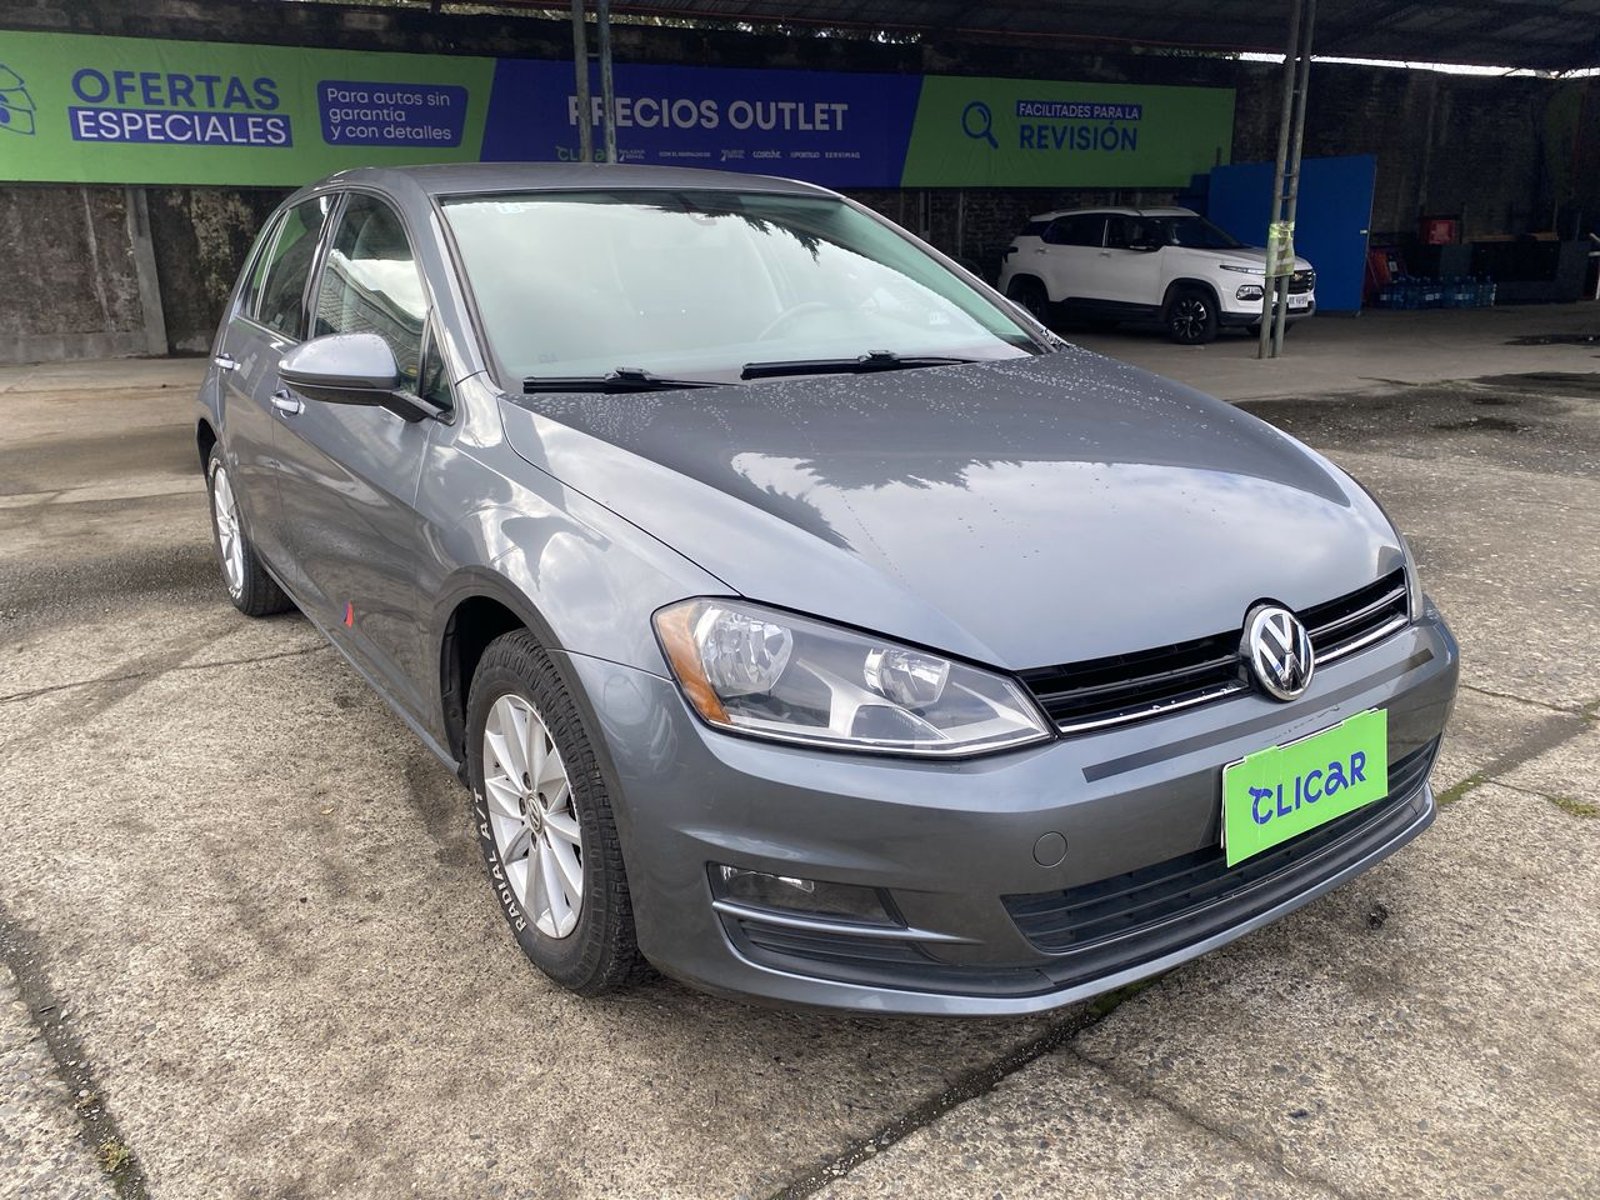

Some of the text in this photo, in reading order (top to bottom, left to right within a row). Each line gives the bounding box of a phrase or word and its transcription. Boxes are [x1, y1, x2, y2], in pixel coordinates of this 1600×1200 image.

[71, 68, 280, 110] OFERTAS
[327, 87, 451, 107] Para autos sin
[329, 105, 406, 124] garantía
[728, 100, 849, 131] OUTLET
[1019, 103, 1139, 119] FACILITADES PARA LA
[78, 110, 287, 146] ESPECIALES
[330, 124, 452, 142] y con detalles
[1019, 122, 1137, 151] REVISIÓN
[473, 788, 528, 932] RADIAL A/T
